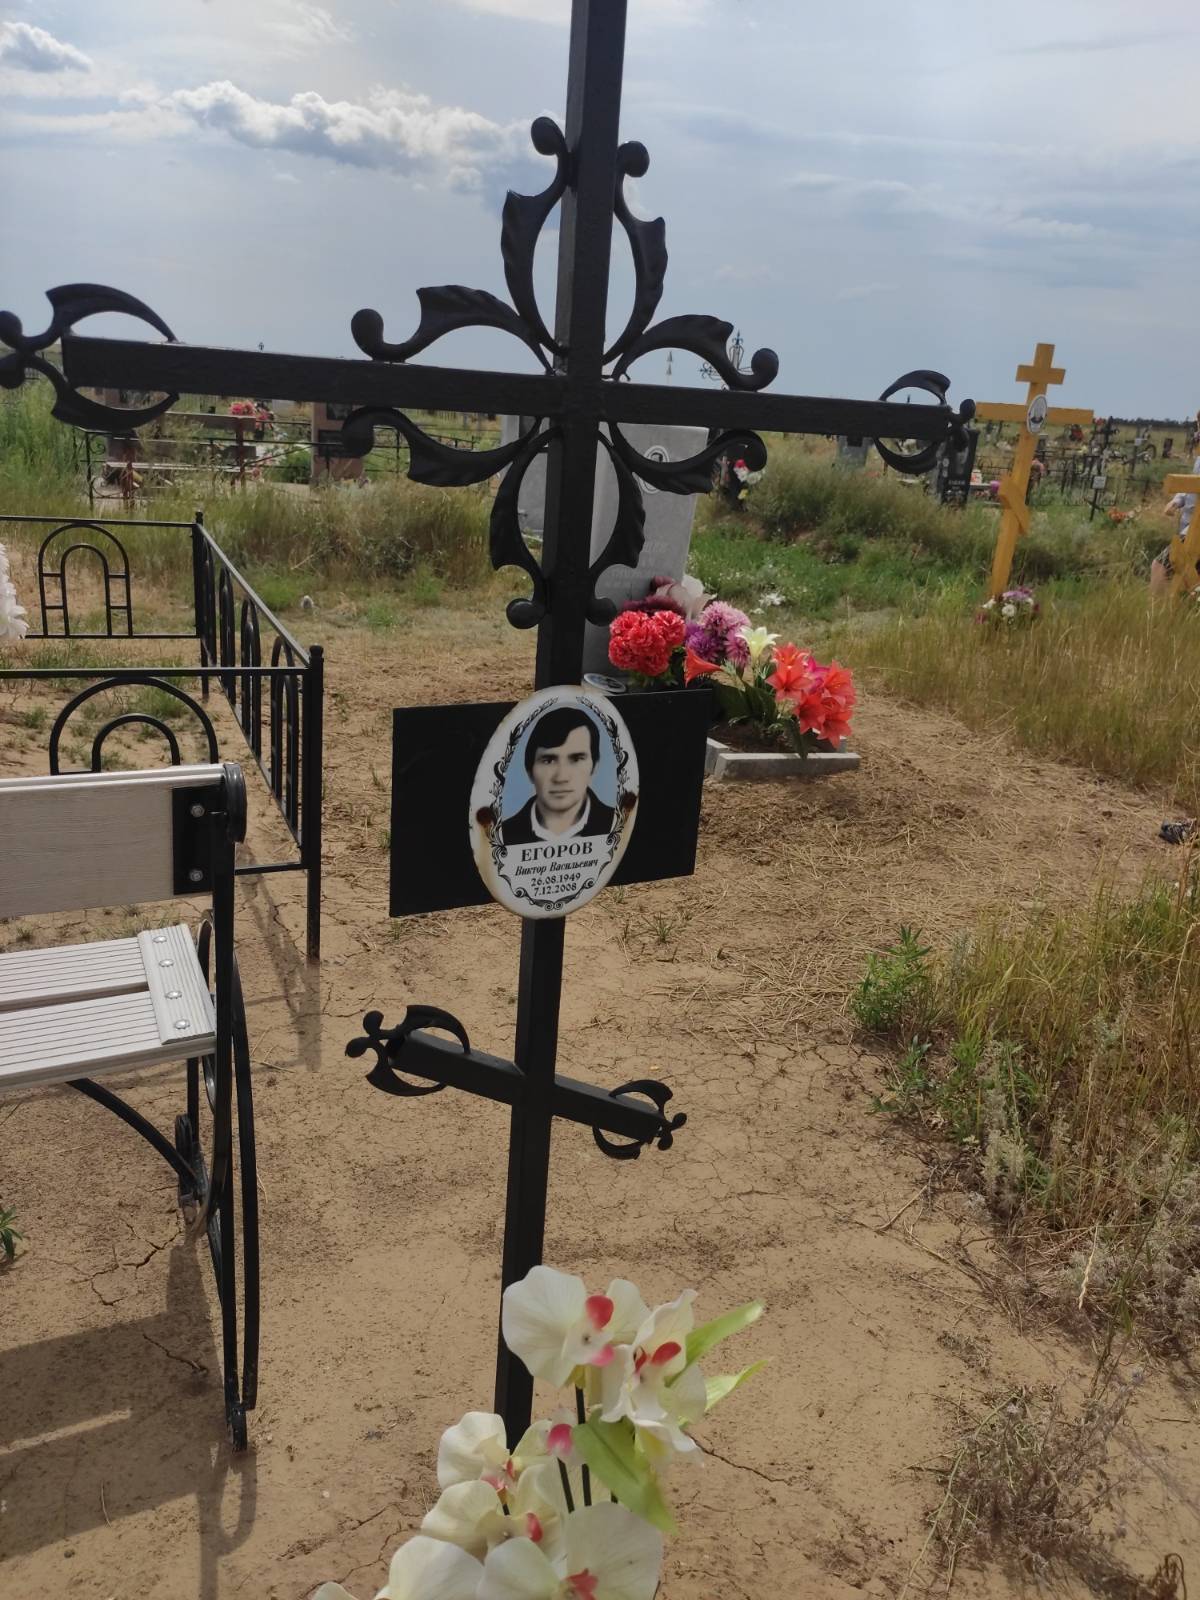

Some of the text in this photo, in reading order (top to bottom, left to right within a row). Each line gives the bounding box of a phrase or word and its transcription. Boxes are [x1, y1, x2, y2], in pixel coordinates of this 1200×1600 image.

[521, 841, 593, 862] ЕГОРОВ
[515, 859, 599, 876] Виктор Васильевич
[531, 872, 581, 887] 26.08.1949
[534, 882, 577, 897] 7.12.2008
